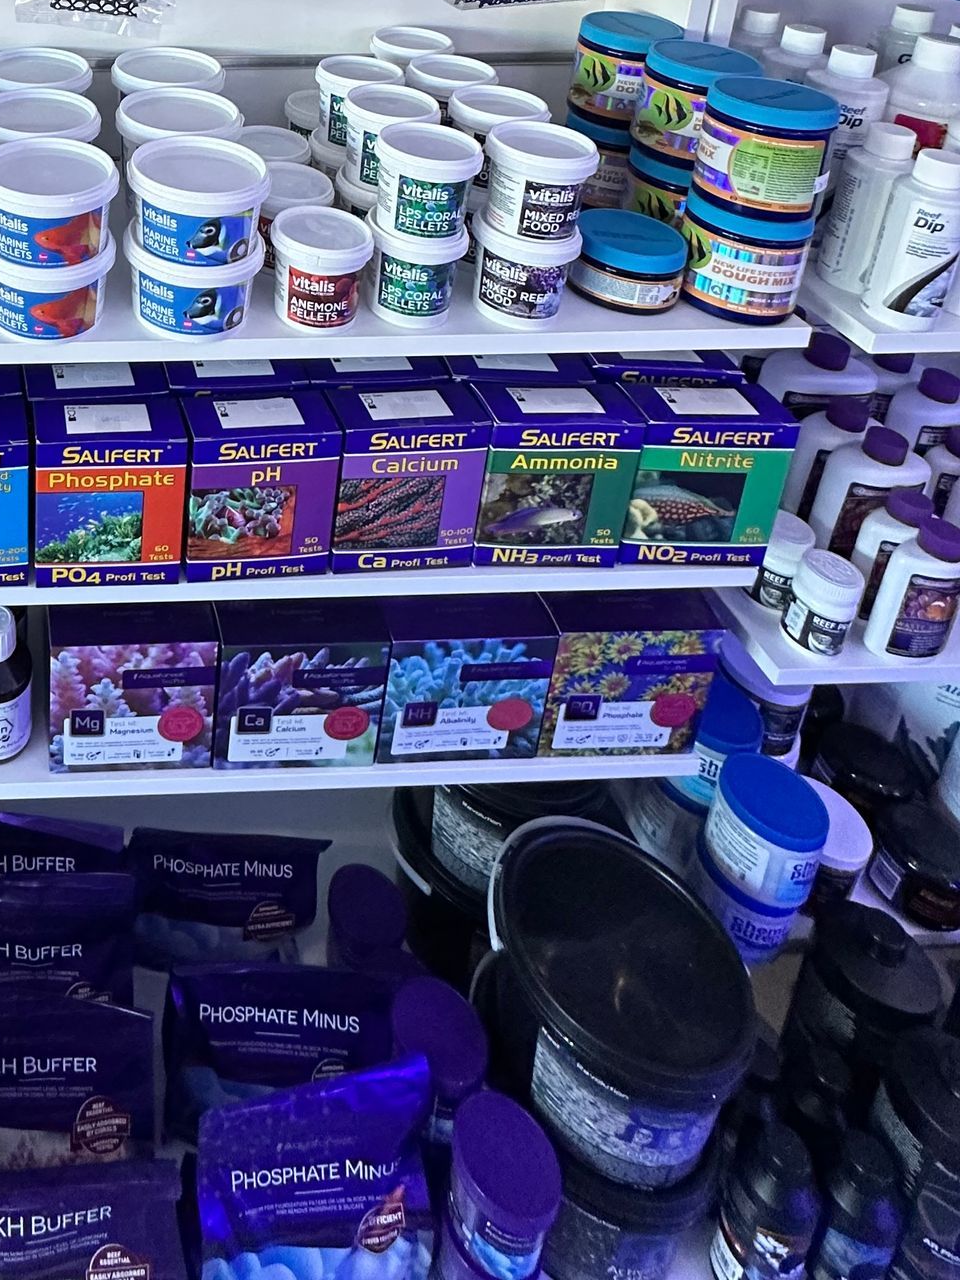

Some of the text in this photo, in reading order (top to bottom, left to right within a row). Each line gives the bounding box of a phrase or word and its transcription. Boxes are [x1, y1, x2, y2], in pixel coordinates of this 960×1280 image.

[403, 183, 448, 201] vitalis
[143, 207, 177, 227] vitalis
[400, 205, 421, 220] LPS
[917, 208, 942, 220] Reef
[398, 217, 449, 231] PELLETS
[914, 216, 945, 234] Dip
[143, 226, 177, 246] MARINE
[143, 236, 179, 256] GRAZER
[485, 257, 528, 282] vitalis
[712, 266, 794, 287] DOUGH MIX
[292, 275, 335, 292] vitalis
[482, 276, 550, 304] MIXED REEF
[290, 296, 348, 311] ANEMONE
[482, 289, 512, 307] FOOD
[290, 306, 338, 321] PELLETS
[369, 432, 468, 450] SALIFERT
[519, 429, 620, 447] SALIFERT
[671, 426, 774, 445] SALIFERT
[62, 446, 164, 464] SALIFERT
[218, 442, 318, 461] SALIFERT
[680, 452, 755, 468] Nitrite
[372, 456, 458, 474] Calcium
[510, 454, 618, 470] Ammonia
[49, 471, 174, 490] Phosphate
[251, 466, 281, 486] pH
[358, 553, 448, 568] Ca Profi Test
[492, 548, 538, 564] NH3
[638, 546, 752, 563] NO2 Profi Test
[0, 572, 25, 582] Test
[52, 568, 165, 584] PO4 Profi Test
[211, 562, 242, 581] pH
[75, 716, 99, 731] Mg
[244, 715, 264, 727] Ca
[275, 725, 306, 733] Calcium
[109, 726, 153, 736] Magnesium
[199, 1003, 360, 1033] PHOSPHATE MINUS
[22, 1055, 97, 1074] BUFFER
[231, 1158, 402, 1193] PHOSPHATE MINU
[30, 1204, 113, 1233] BUFFER
